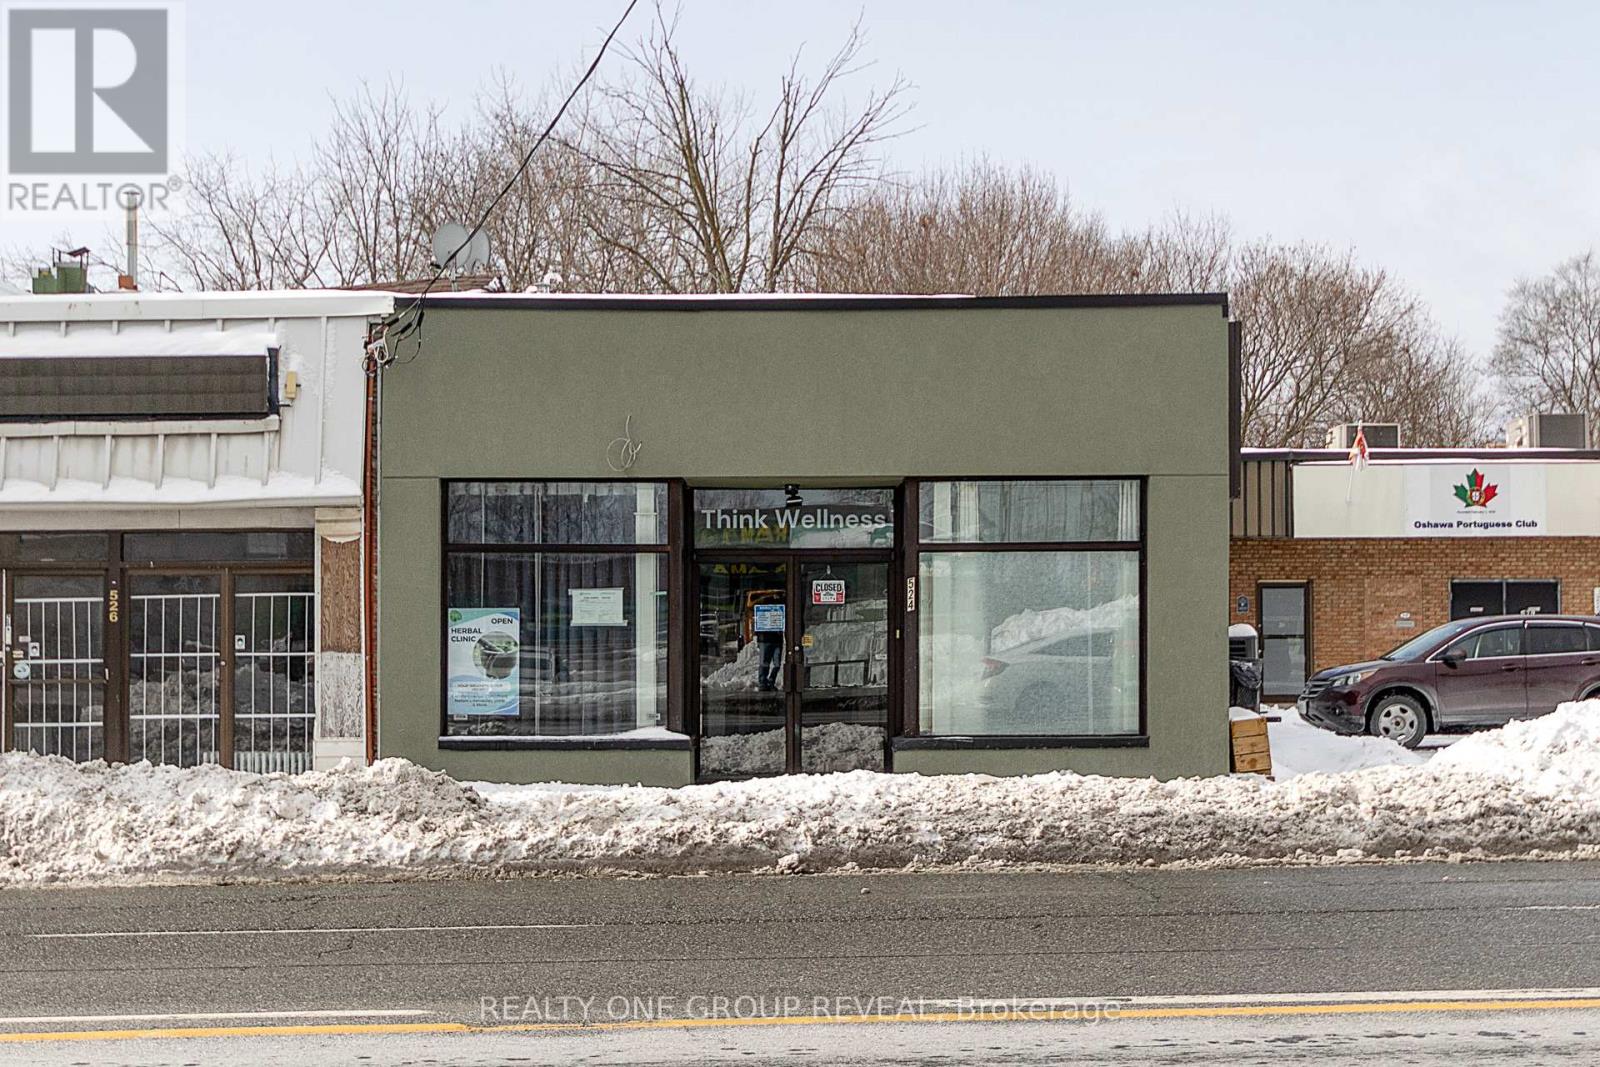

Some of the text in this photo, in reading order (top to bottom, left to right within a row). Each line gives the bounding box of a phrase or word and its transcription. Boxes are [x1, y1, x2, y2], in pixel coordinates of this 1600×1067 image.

[701, 509, 886, 529] Think Wellness
[1456, 521, 1512, 530] Portuguese
[1515, 520, 1538, 528] Club
[815, 583, 842, 592] CLOSED
[109, 590, 118, 622] 526
